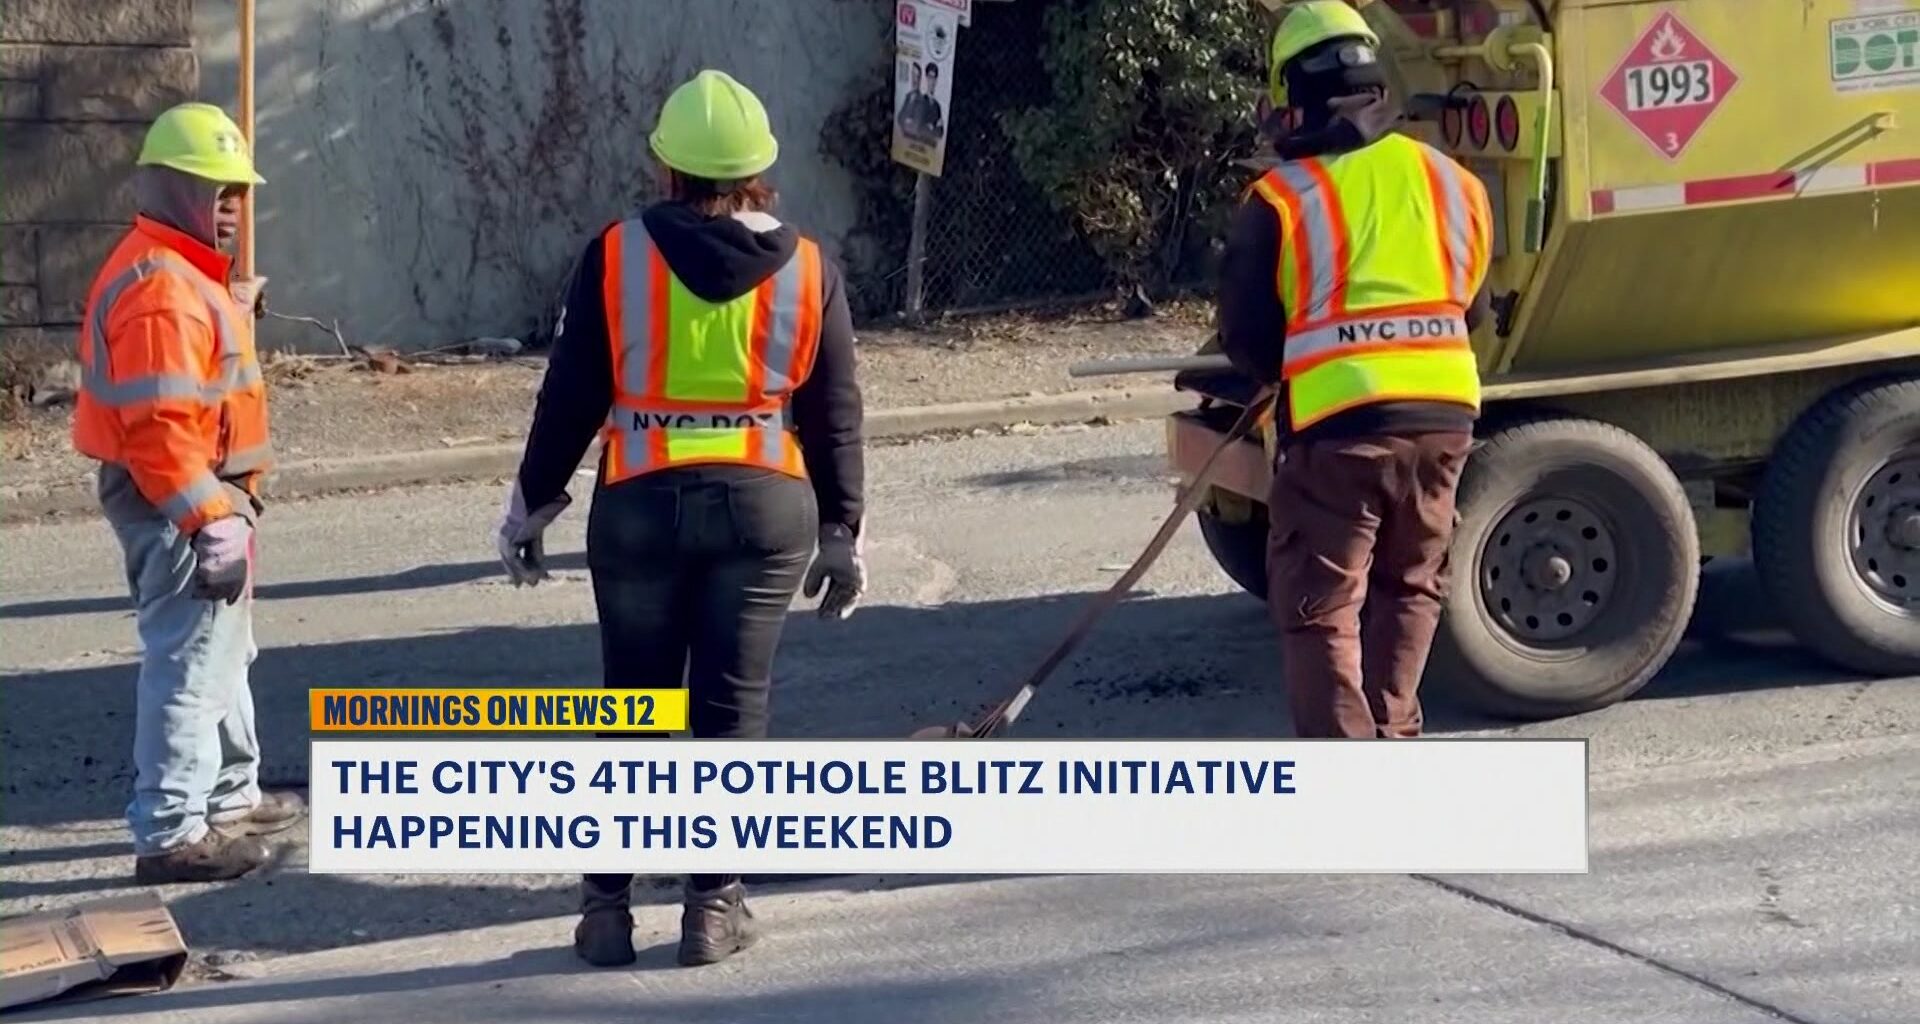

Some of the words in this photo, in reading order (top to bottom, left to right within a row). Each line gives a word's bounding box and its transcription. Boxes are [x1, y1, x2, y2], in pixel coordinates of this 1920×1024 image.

[1835, 30, 1918, 75] DOT
[1628, 63, 1710, 108] 1993
[1665, 132, 1679, 150] 3
[1338, 321, 1396, 342] NYC
[633, 411, 696, 431] NYC
